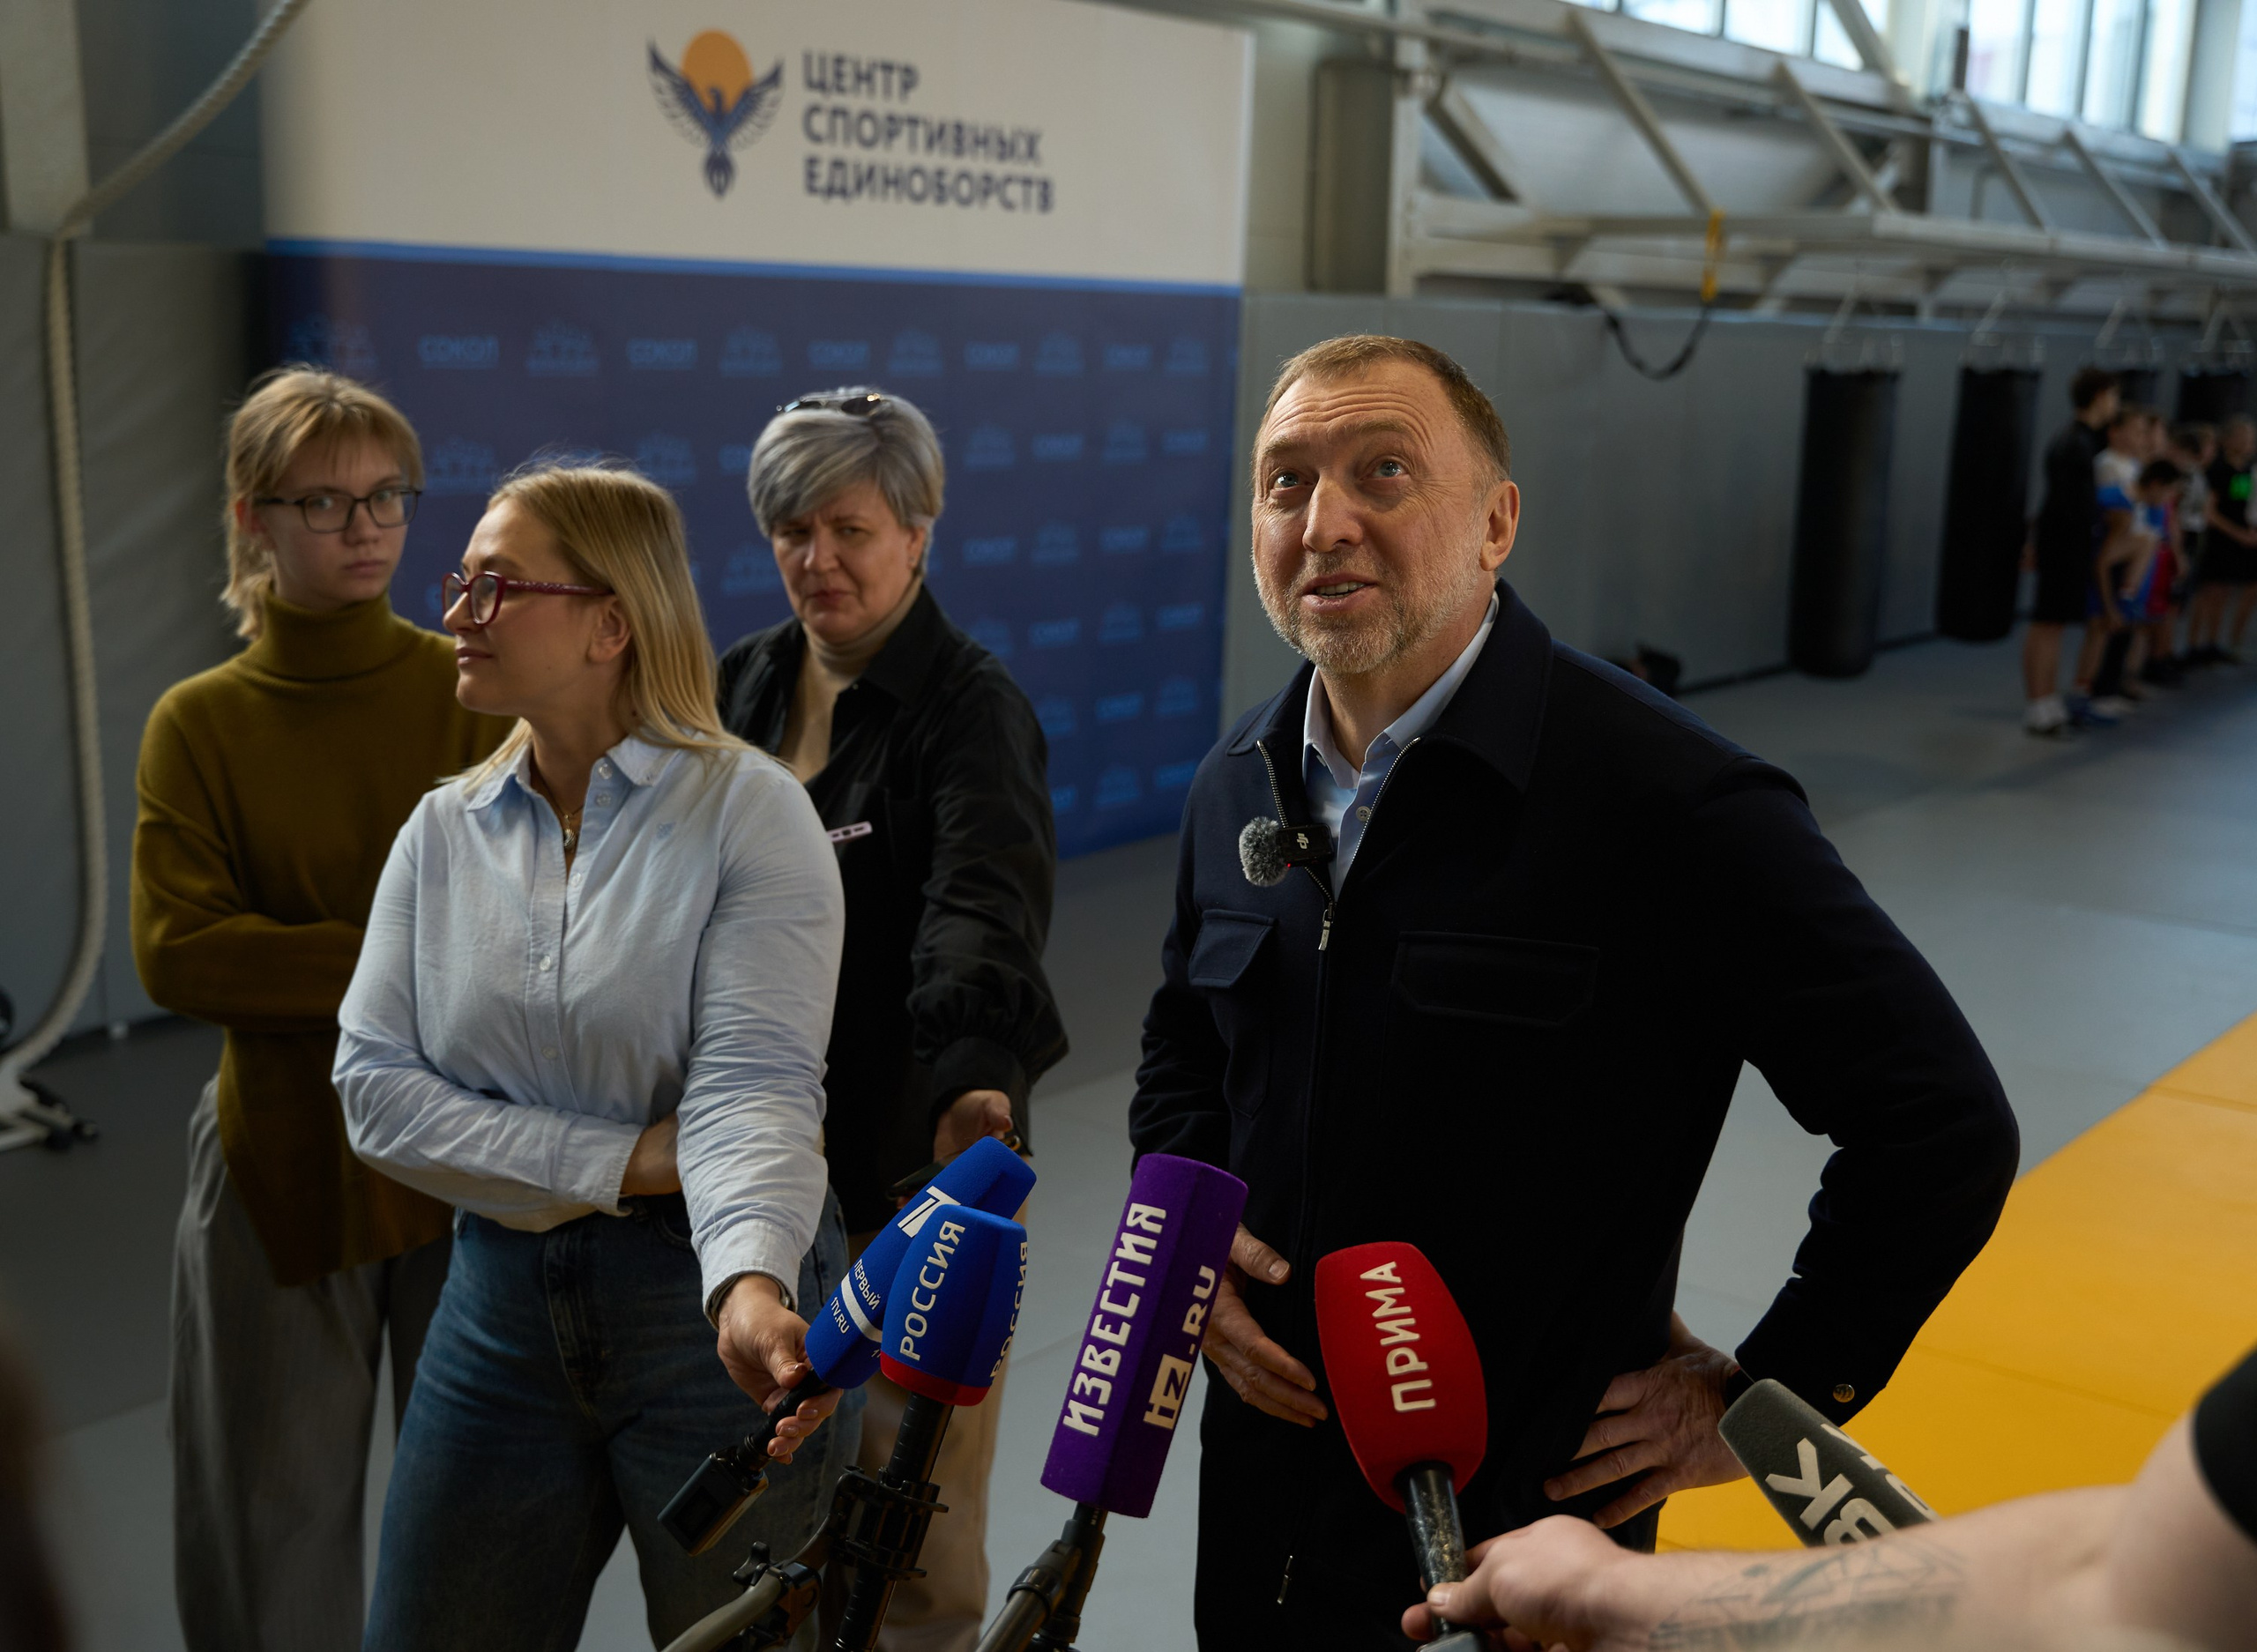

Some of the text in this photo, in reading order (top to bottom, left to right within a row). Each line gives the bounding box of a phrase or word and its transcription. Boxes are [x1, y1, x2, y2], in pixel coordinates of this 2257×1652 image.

[803, 49, 919, 103] ЦЕНТР
[802, 103, 1042, 165] СПОРТИВНЫХ
[804, 155, 1054, 214] ЕДИНОБОРСТВ
[854, 1258, 882, 1311] ПЕРВЫЙ
[899, 1221, 965, 1361] РОССИЯ
[831, 1297, 850, 1335] 1TV.RU
[1062, 1202, 1166, 1437] ИЗВЕСТИЯ
[1359, 1261, 1436, 1412] ПРИМА
